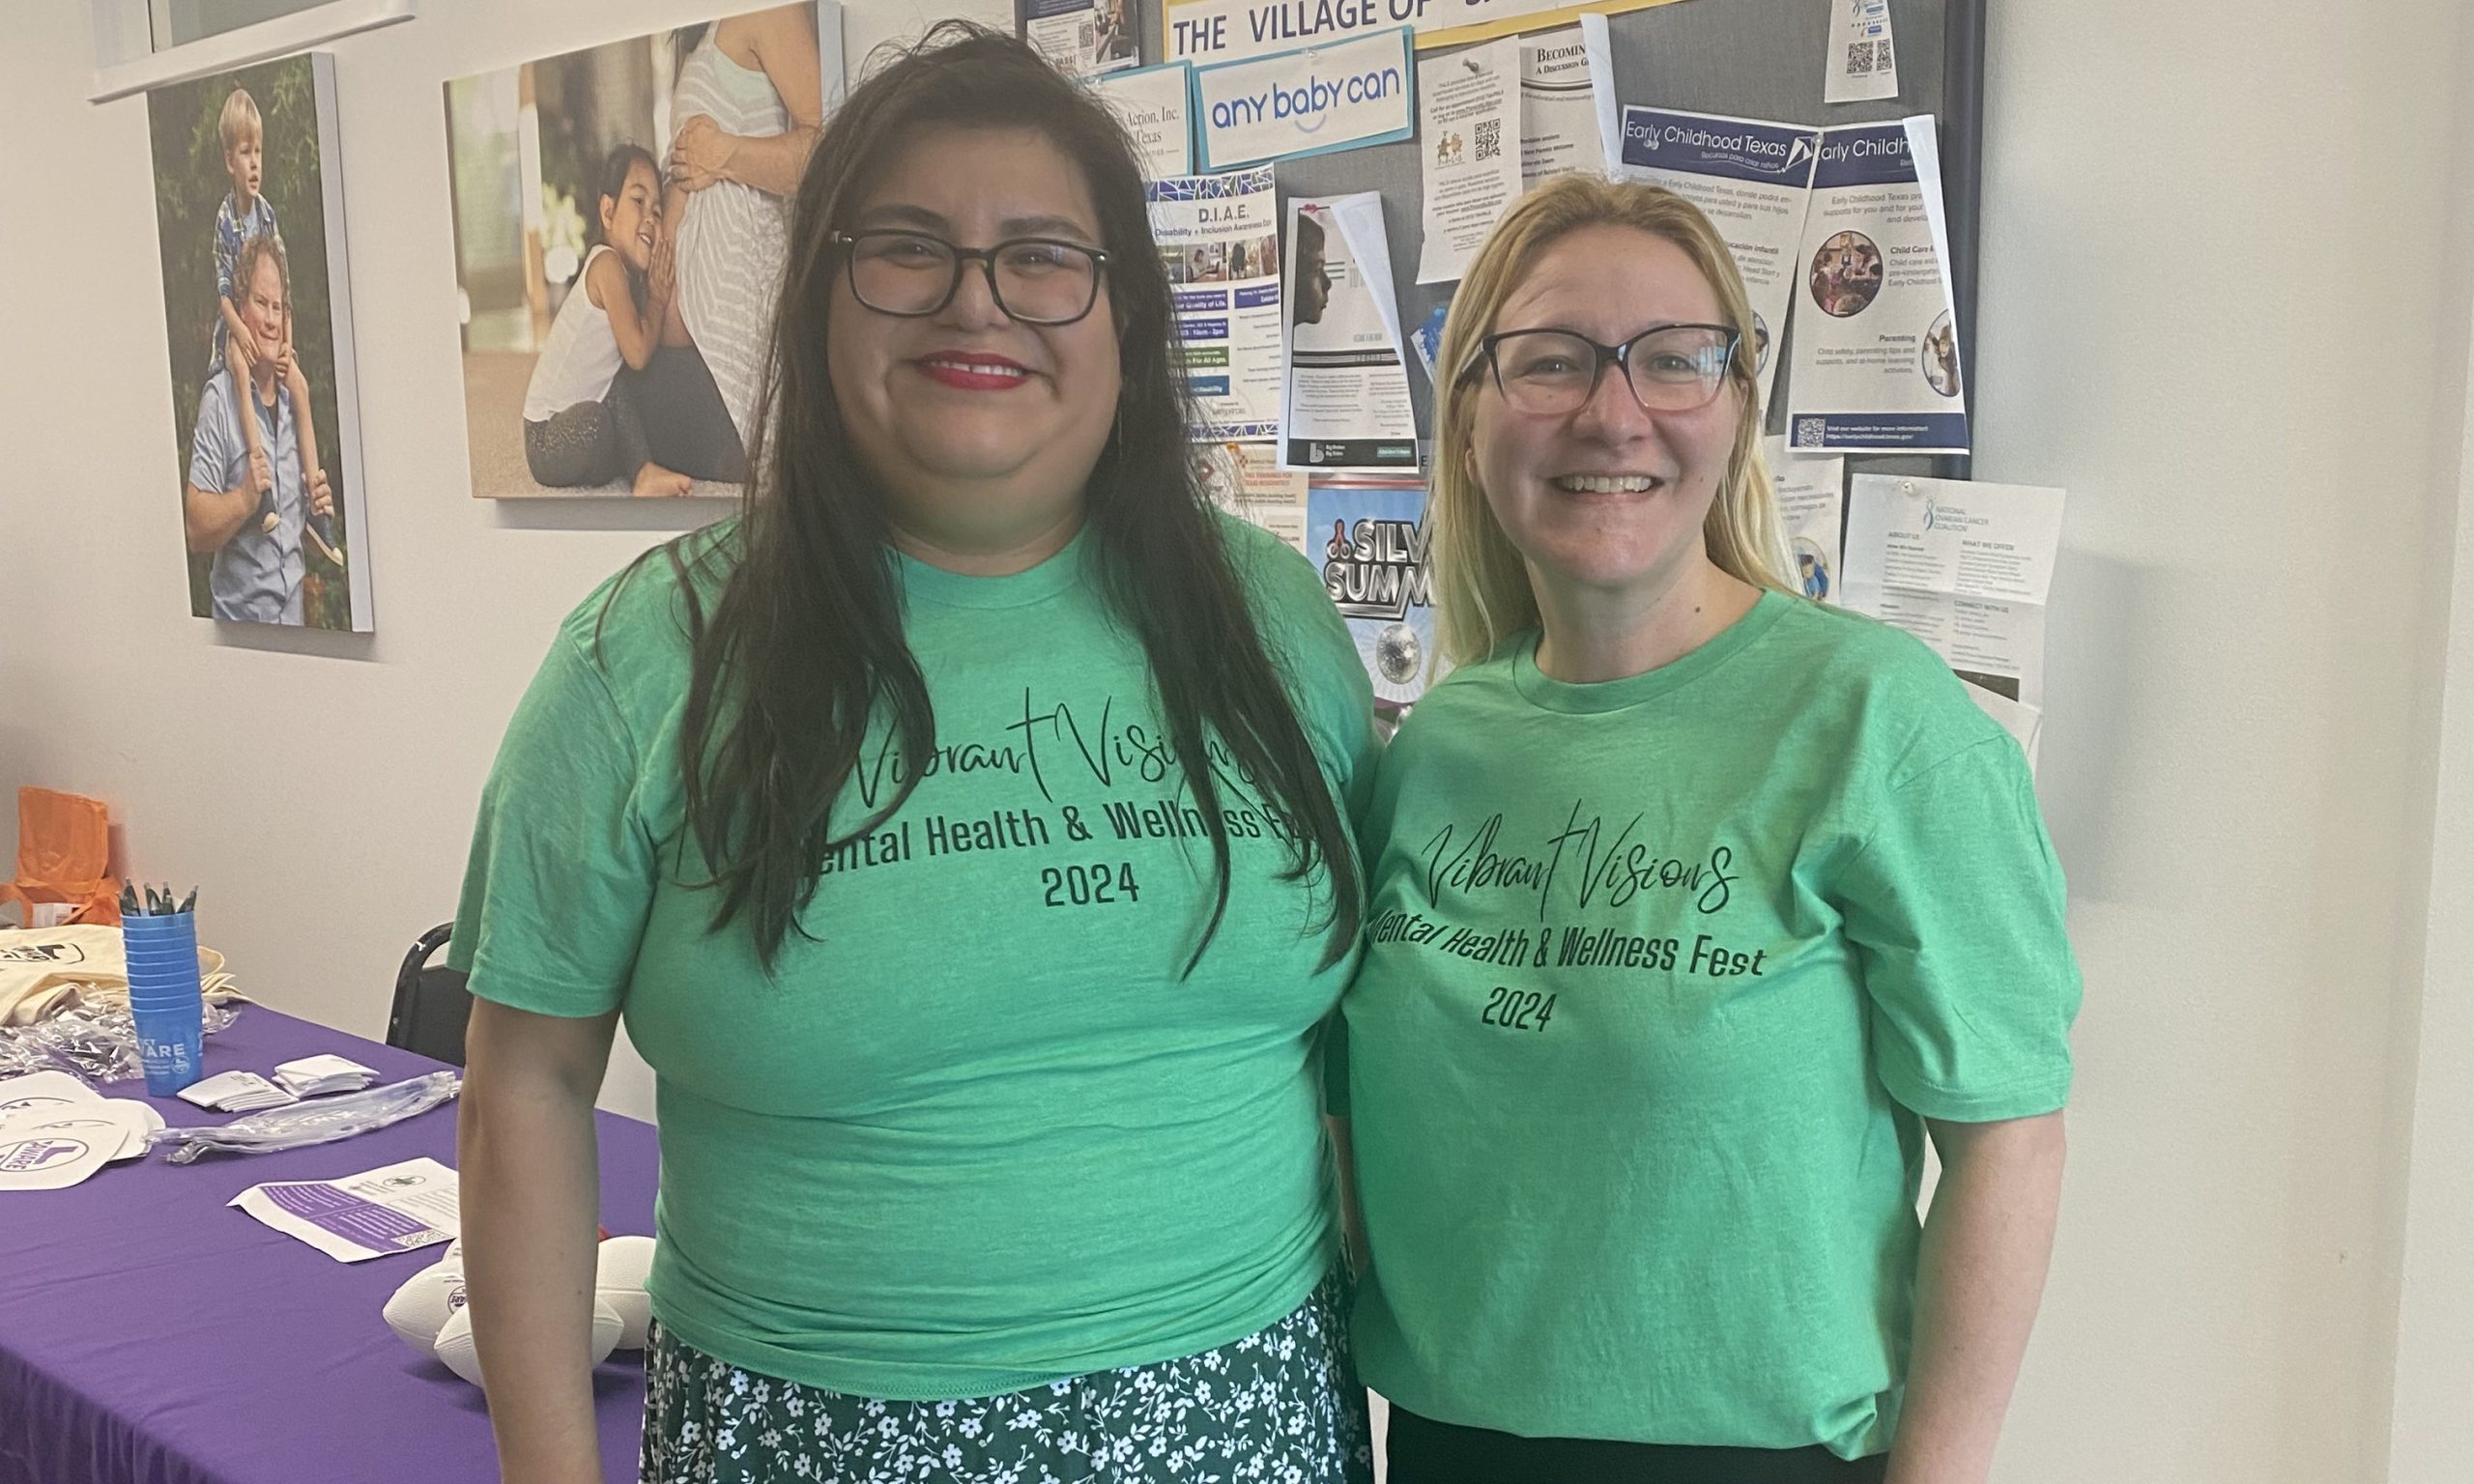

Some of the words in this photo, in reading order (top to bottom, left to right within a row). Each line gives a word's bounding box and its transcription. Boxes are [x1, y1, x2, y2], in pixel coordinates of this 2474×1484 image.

[1173, 14, 1227, 55] THE
[1250, 0, 1377, 43] VILLAGE
[1536, 66, 1542, 75] A
[1543, 61, 1579, 74] DISCUSSION
[1212, 93, 1269, 129] any
[1273, 75, 1344, 121] baby
[1347, 68, 1400, 103] can
[1162, 106, 1180, 122] Inc.
[1136, 131, 1163, 146] Texas
[1626, 121, 1661, 142] Early
[1664, 126, 1742, 151] Childhood
[1745, 135, 1787, 157] Texas
[1701, 151, 1729, 160] Recursos
[1729, 154, 1744, 163] para
[1818, 143, 1850, 162] arly
[1669, 179, 1683, 190] Early
[1684, 181, 1714, 193] Childhood
[1737, 189, 1758, 200] donde
[1718, 197, 1737, 207] usted
[1742, 201, 1758, 211] para
[1831, 196, 1848, 205] Early
[1849, 194, 1885, 204] Childhood
[1198, 204, 1250, 223] D.I.A.E.
[1908, 204, 1924, 214] your
[1156, 227, 1193, 238] Disability
[1200, 223, 1232, 235] Inclusion
[1890, 258, 1908, 267] Child
[1879, 334, 1915, 343] Parenting
[1936, 505, 1966, 516] NATIONAL
[1934, 523, 1968, 532] COALITION
[1935, 514, 1964, 525] OVARIAN
[1964, 516, 1989, 527] CANCER
[1888, 530, 1911, 540] ABOUT
[1962, 539, 1981, 549] WHAT
[1982, 541, 1992, 550] WE
[1994, 542, 2014, 552] OFFER
[1954, 600, 1983, 610] CONNECT
[1984, 603, 1999, 612] WITH
[821, 821, 911, 875] ental
[926, 809, 1050, 856] Health
[1062, 805, 1093, 842] &
[1103, 799, 1261, 840] Wellnss
[1422, 798, 1588, 923] Vibrant
[1576, 812, 1740, 914] Visions
[1042, 862, 1139, 907] 2024
[1440, 928, 1530, 967] Health
[1534, 927, 1553, 967] &
[1558, 926, 1680, 971] Wellness
[1689, 933, 1768, 978] Fest
[1482, 986, 1558, 1033] 2024
